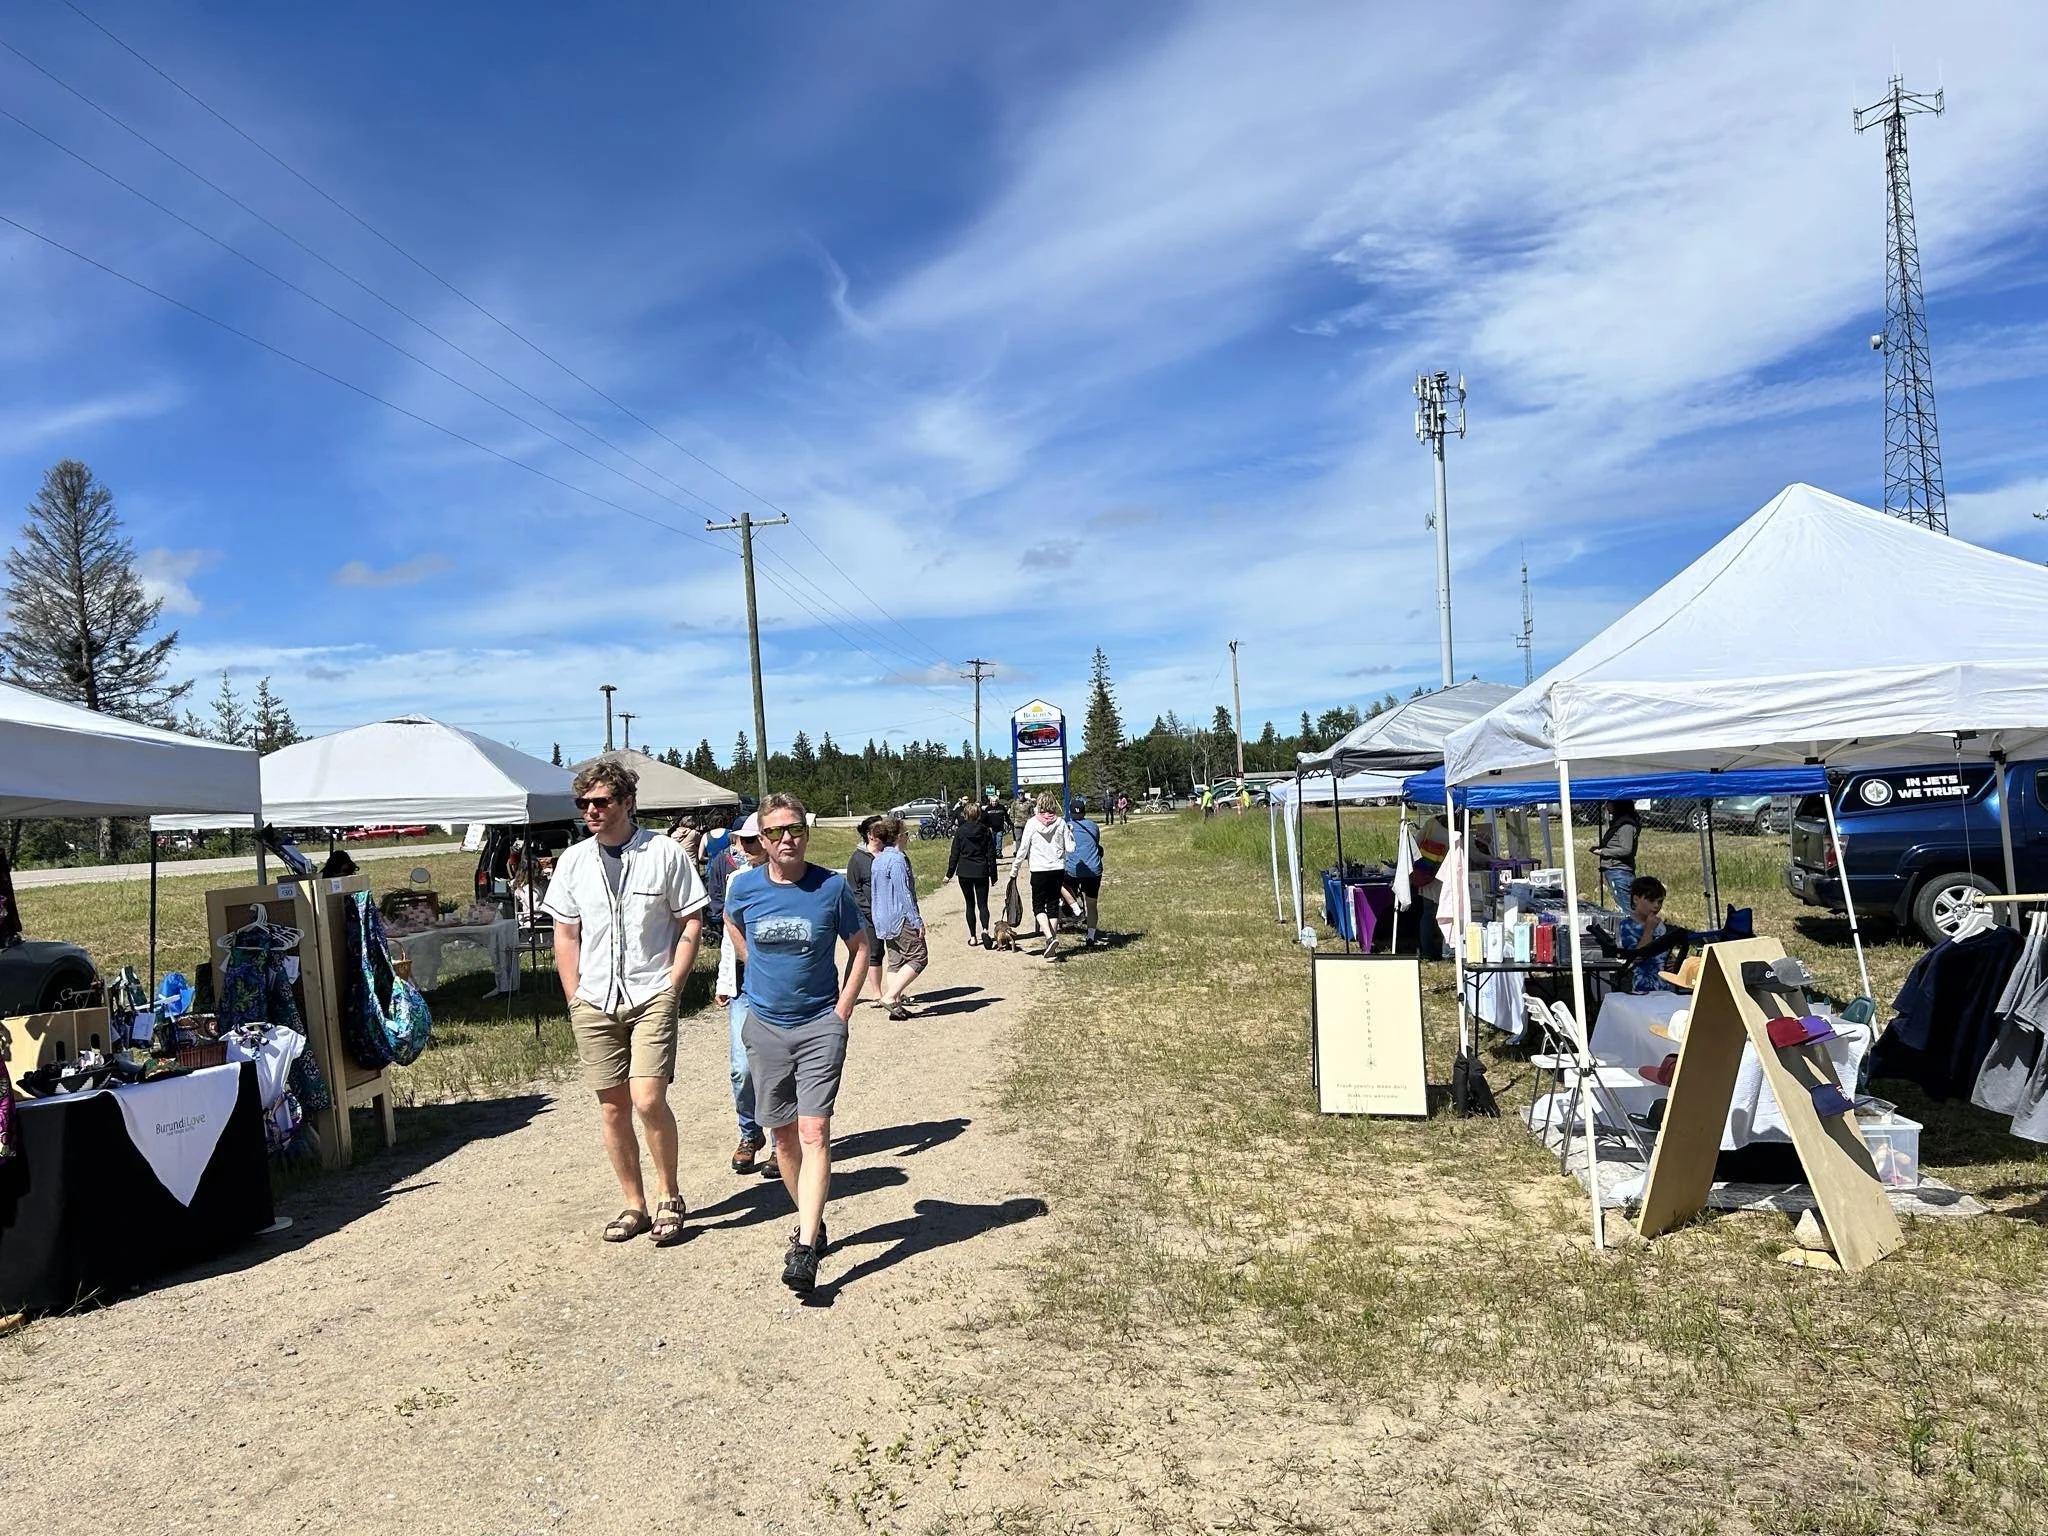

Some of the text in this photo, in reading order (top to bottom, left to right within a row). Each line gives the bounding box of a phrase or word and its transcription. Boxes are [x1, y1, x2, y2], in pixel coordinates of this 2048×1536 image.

[1905, 774, 1959, 787] IN JETS
[1897, 784, 1970, 799] WE TRUST
